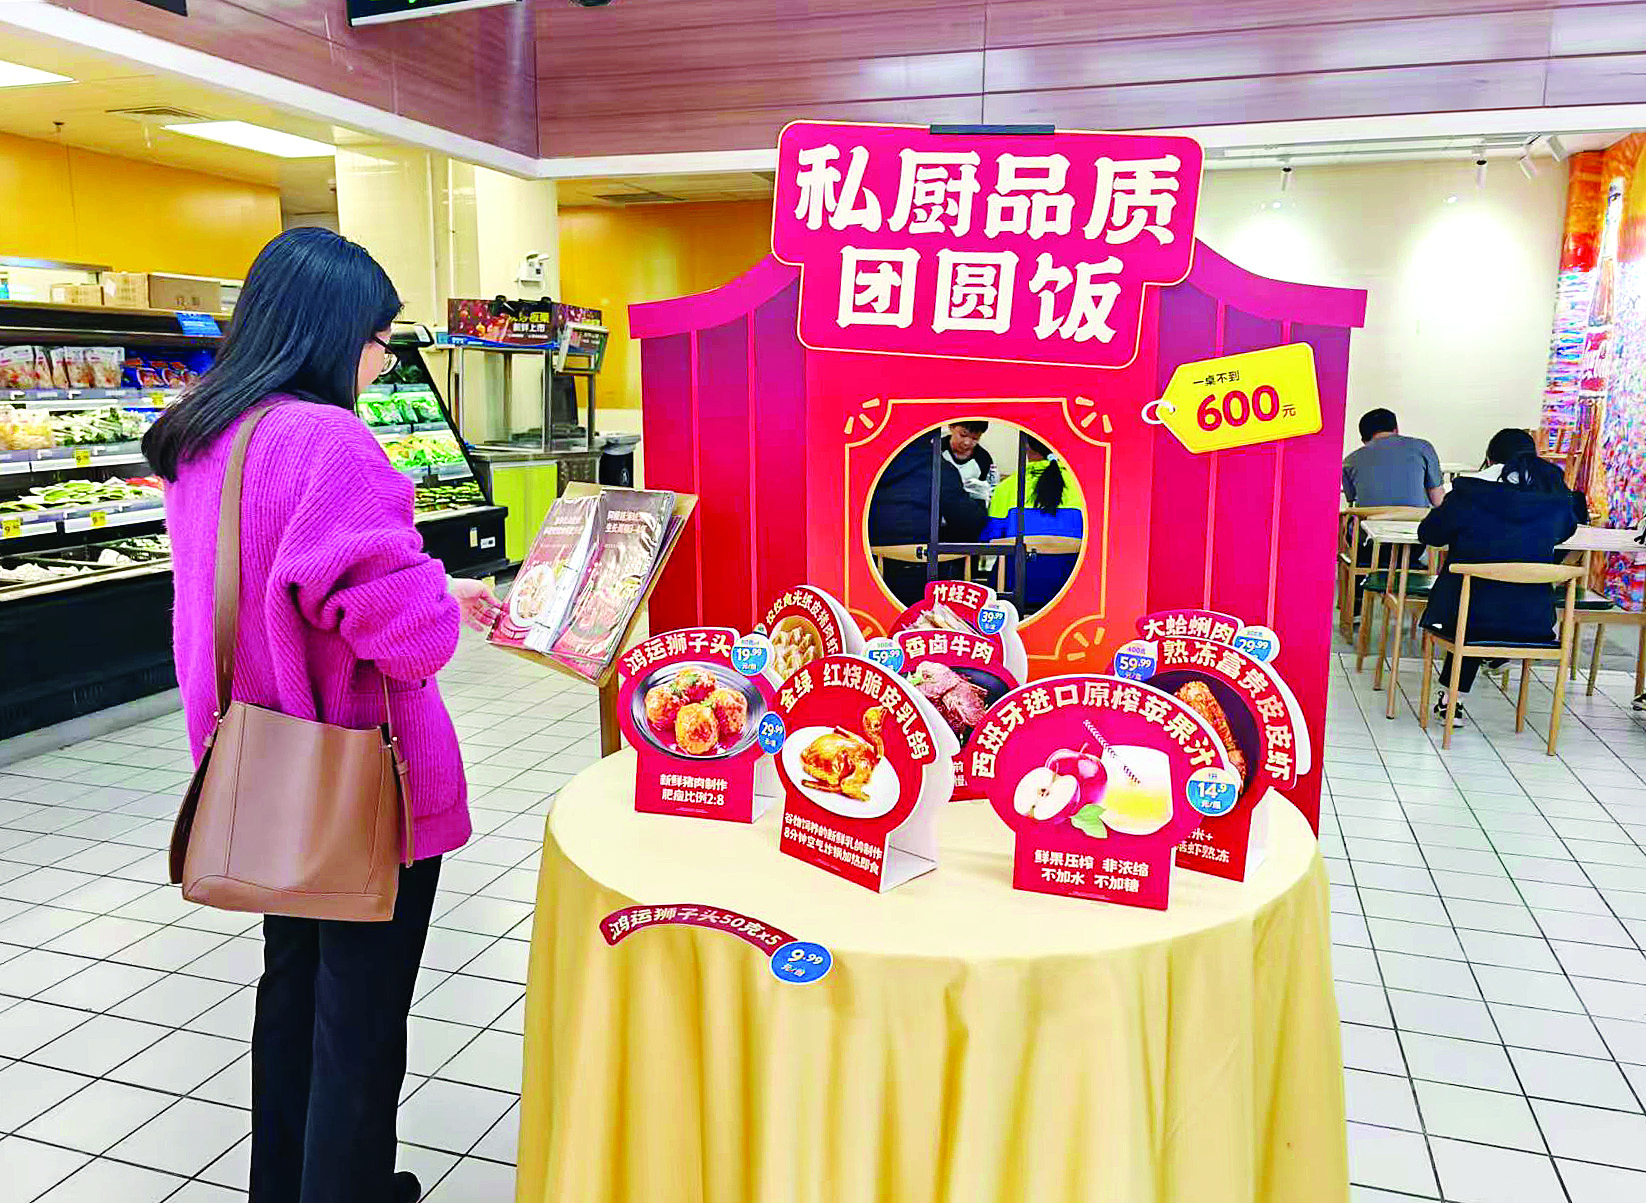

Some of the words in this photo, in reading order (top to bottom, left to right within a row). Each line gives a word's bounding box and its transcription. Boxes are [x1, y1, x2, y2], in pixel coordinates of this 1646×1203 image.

[794, 143, 1182, 246] 私厨品质
[836, 246, 1125, 344] 团圆饭
[1193, 370, 1240, 386] 一桌不到
[933, 584, 981, 609] 竹蛏王
[982, 611, 1004, 623] 39.99
[1143, 614, 1235, 644] 大蛤蜊肉
[624, 632, 731, 676] 鸿运狮子头
[737, 648, 762, 661] 19.99
[872, 650, 899, 664] 59.99
[905, 633, 994, 664] 香卤牛肉
[1238, 639, 1269, 653] 29.99
[1120, 656, 1151, 671] 59.99
[780, 669, 814, 713] 金绿
[823, 662, 930, 760] 红烧脆皮乳鸽
[1162, 640, 1293, 781] 熟冻富贵皮皮虾
[762, 721, 784, 737] 29.99
[972, 681, 1216, 779] 西班牙进口原榨苹果汁
[660, 774, 728, 791] 新鲜猪肉制作
[1197, 782, 1227, 798] 14.9
[1034, 849, 1094, 870] 鲜果压榨
[1102, 858, 1149, 877] 非浓缩
[1041, 867, 1085, 886] 不加水
[1093, 875, 1139, 893] 不加糖
[609, 906, 782, 946] 鸿运狮子头50克x5
[788, 949, 823, 965] 9.99
